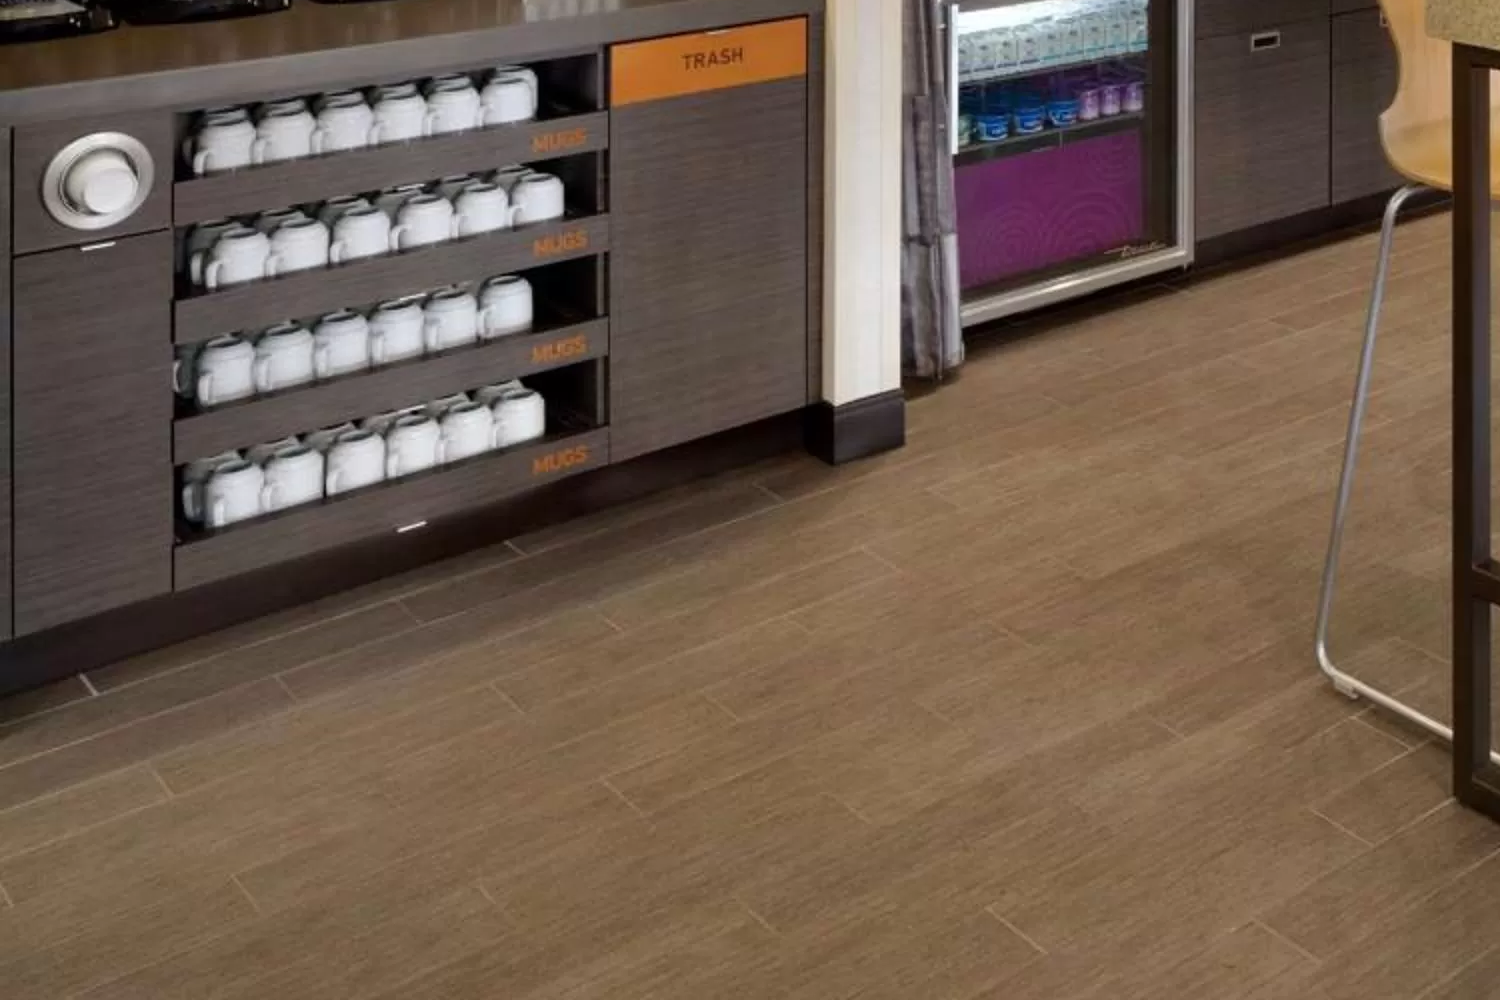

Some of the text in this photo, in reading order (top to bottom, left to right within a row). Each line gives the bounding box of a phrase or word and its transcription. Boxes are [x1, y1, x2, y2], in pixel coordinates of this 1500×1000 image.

[681, 46, 743, 72] TRASH
[531, 128, 587, 153] MUGS
[532, 230, 588, 257] MUGS
[532, 335, 587, 363] MUGS
[531, 446, 588, 476] MUGS
